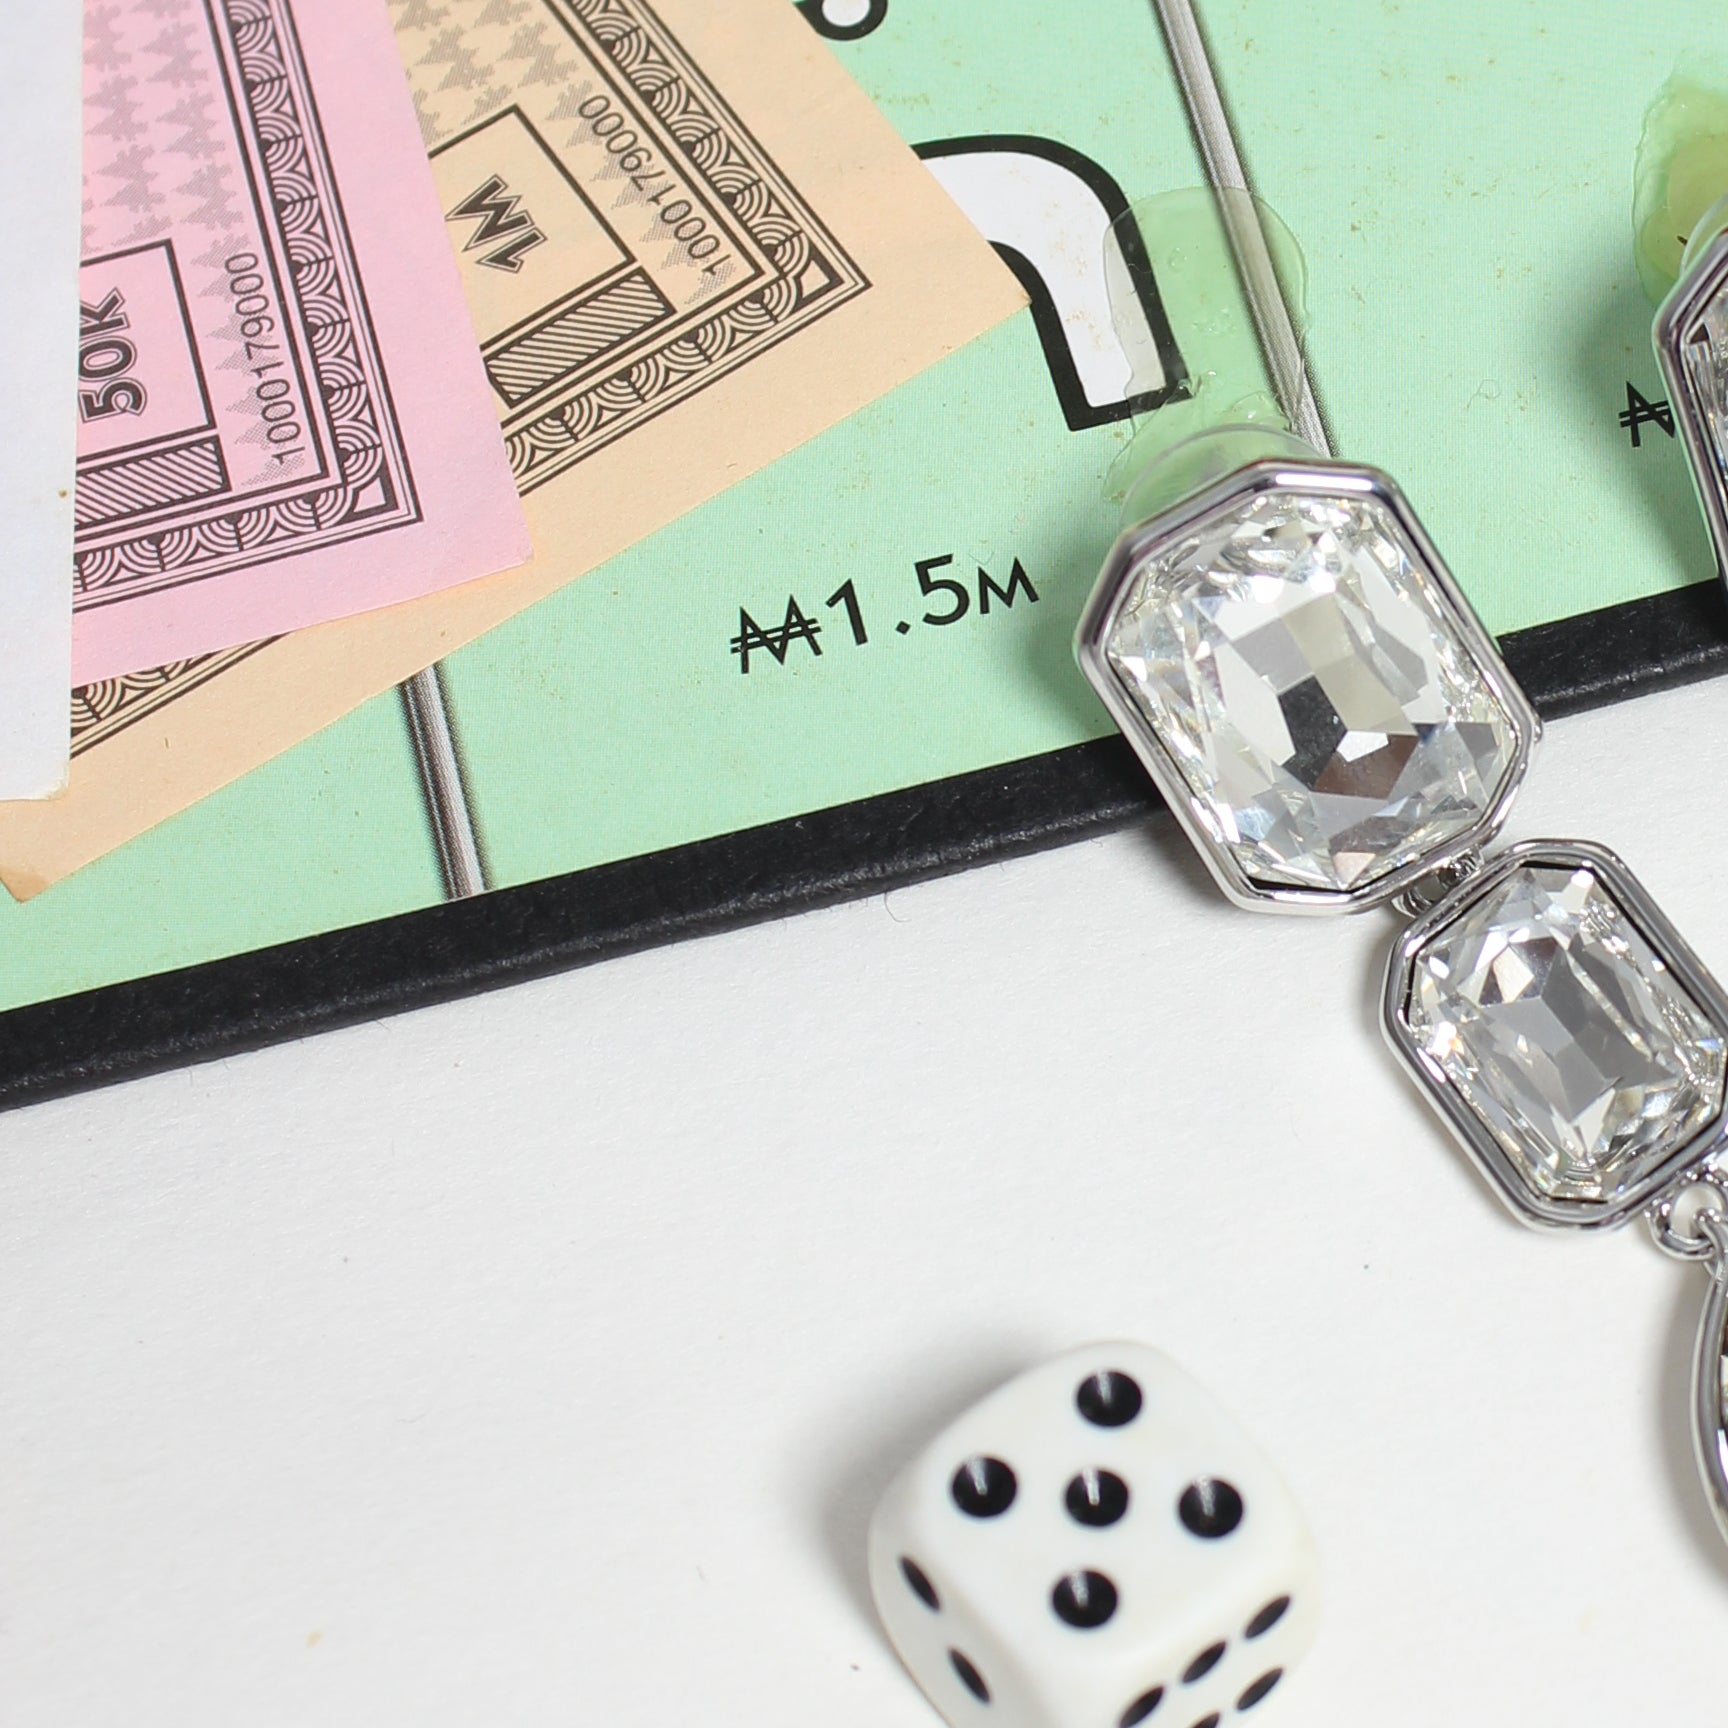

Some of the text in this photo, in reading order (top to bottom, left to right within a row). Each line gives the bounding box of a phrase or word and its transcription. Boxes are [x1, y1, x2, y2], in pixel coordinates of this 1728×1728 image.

[443, 173, 548, 274] 1M
[578, 94, 732, 277] 1000179000
[224, 252, 306, 465] 1000179000
